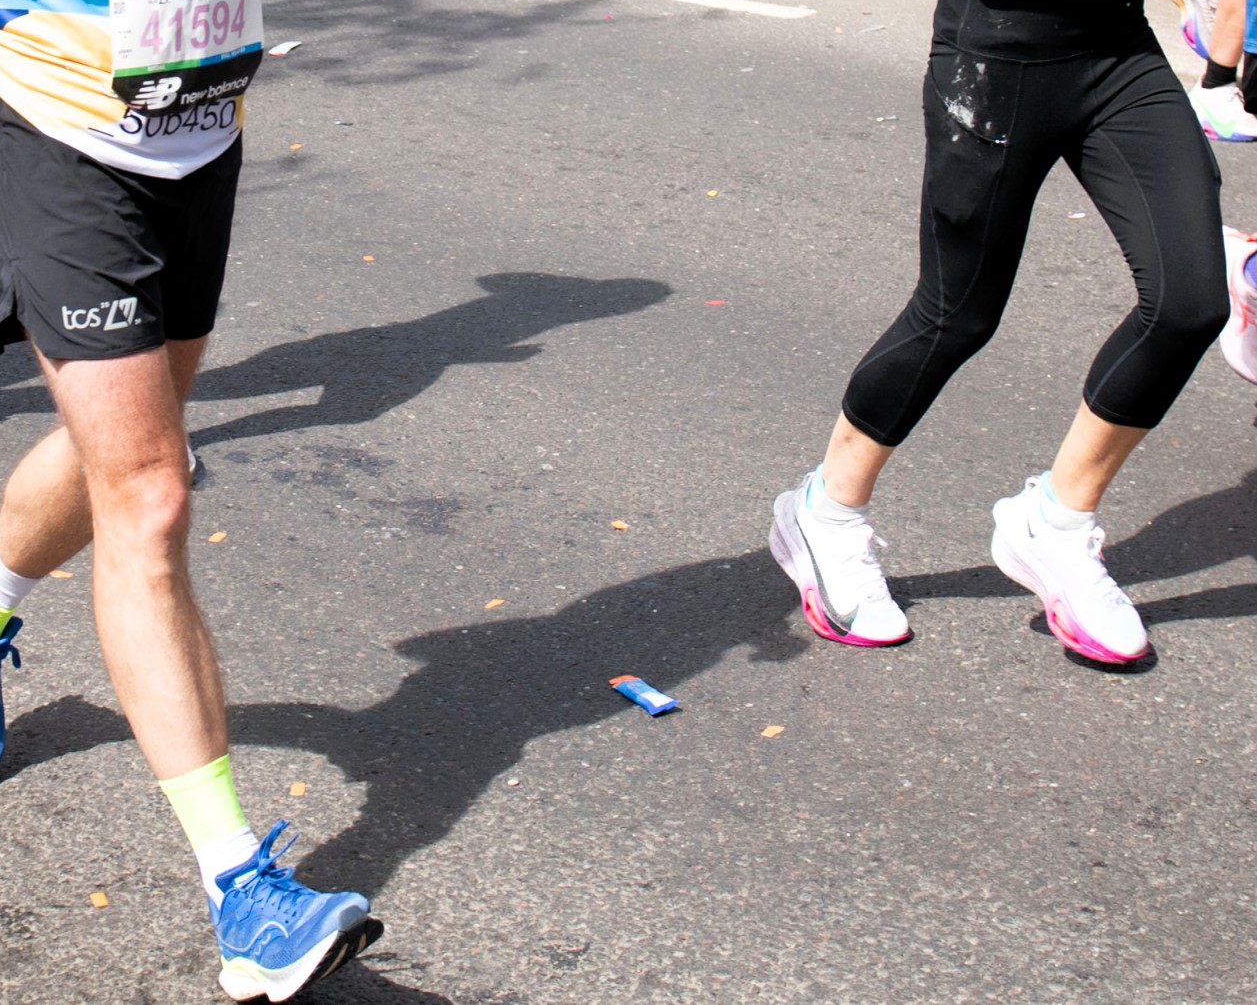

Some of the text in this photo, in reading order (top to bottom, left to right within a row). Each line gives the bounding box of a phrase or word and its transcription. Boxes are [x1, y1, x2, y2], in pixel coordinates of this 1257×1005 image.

[180, 90, 206, 105] new
[207, 76, 250, 98] balance
[61, 305, 102, 330] tcs
